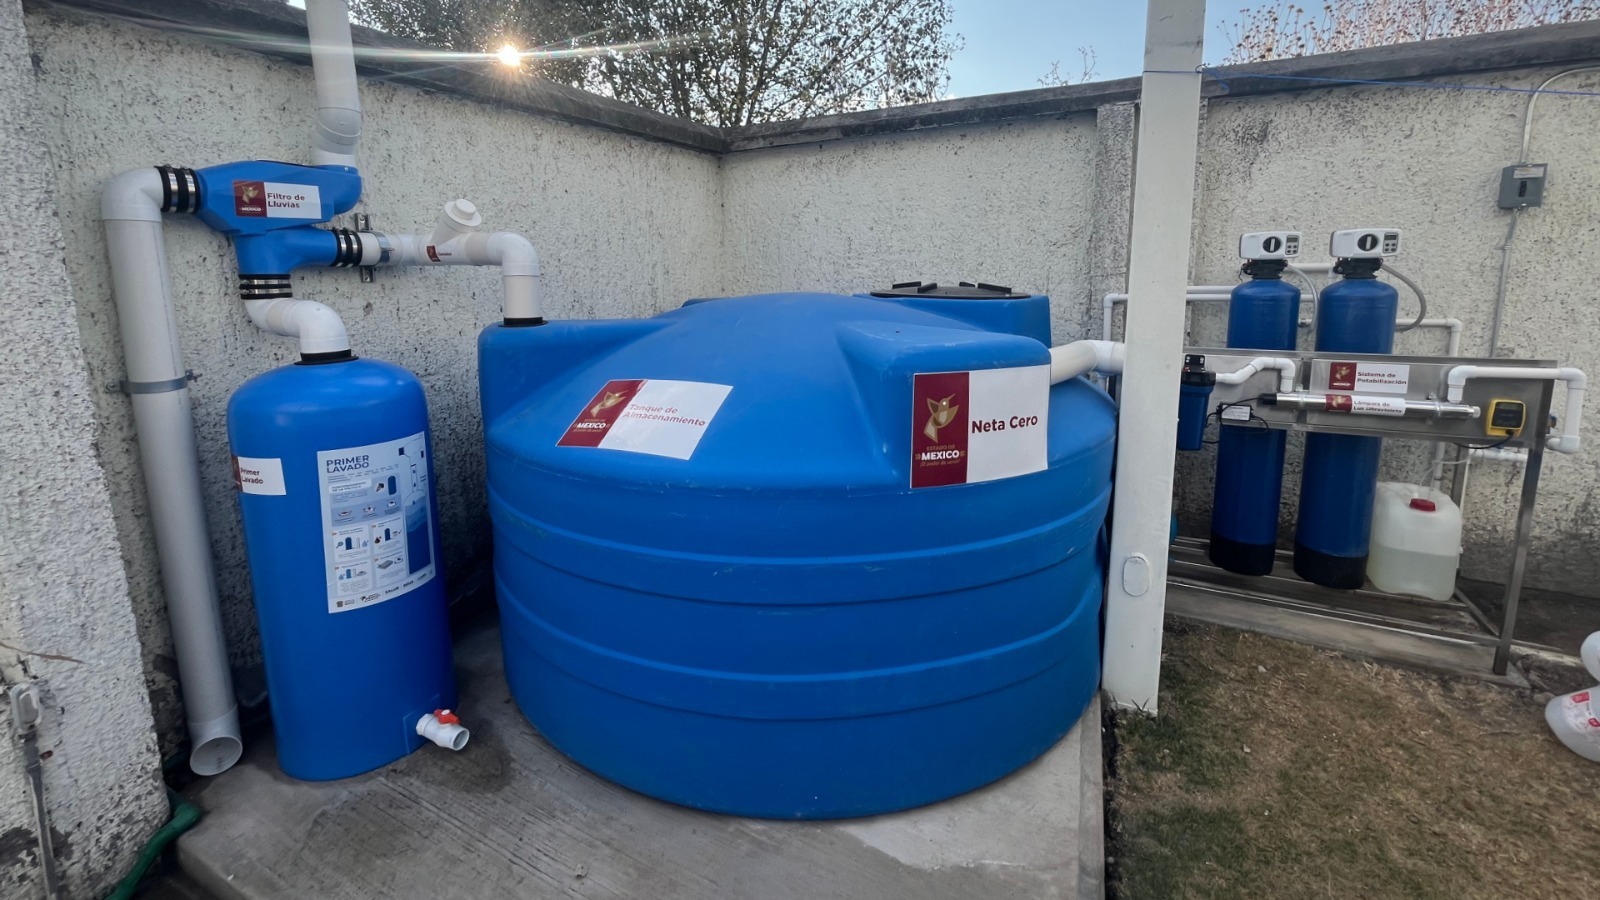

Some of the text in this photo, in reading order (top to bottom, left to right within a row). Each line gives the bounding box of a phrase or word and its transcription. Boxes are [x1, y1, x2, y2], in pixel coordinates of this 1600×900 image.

[630, 404, 662, 414] Tanque
[622, 412, 706, 426] Almacenamiento
[972, 416, 1038, 434] Neta Cero
[326, 455, 370, 467] PRIMER
[240, 468, 260, 476] Primer
[326, 462, 370, 474] LAVADO
[242, 476, 264, 484] Lavado
